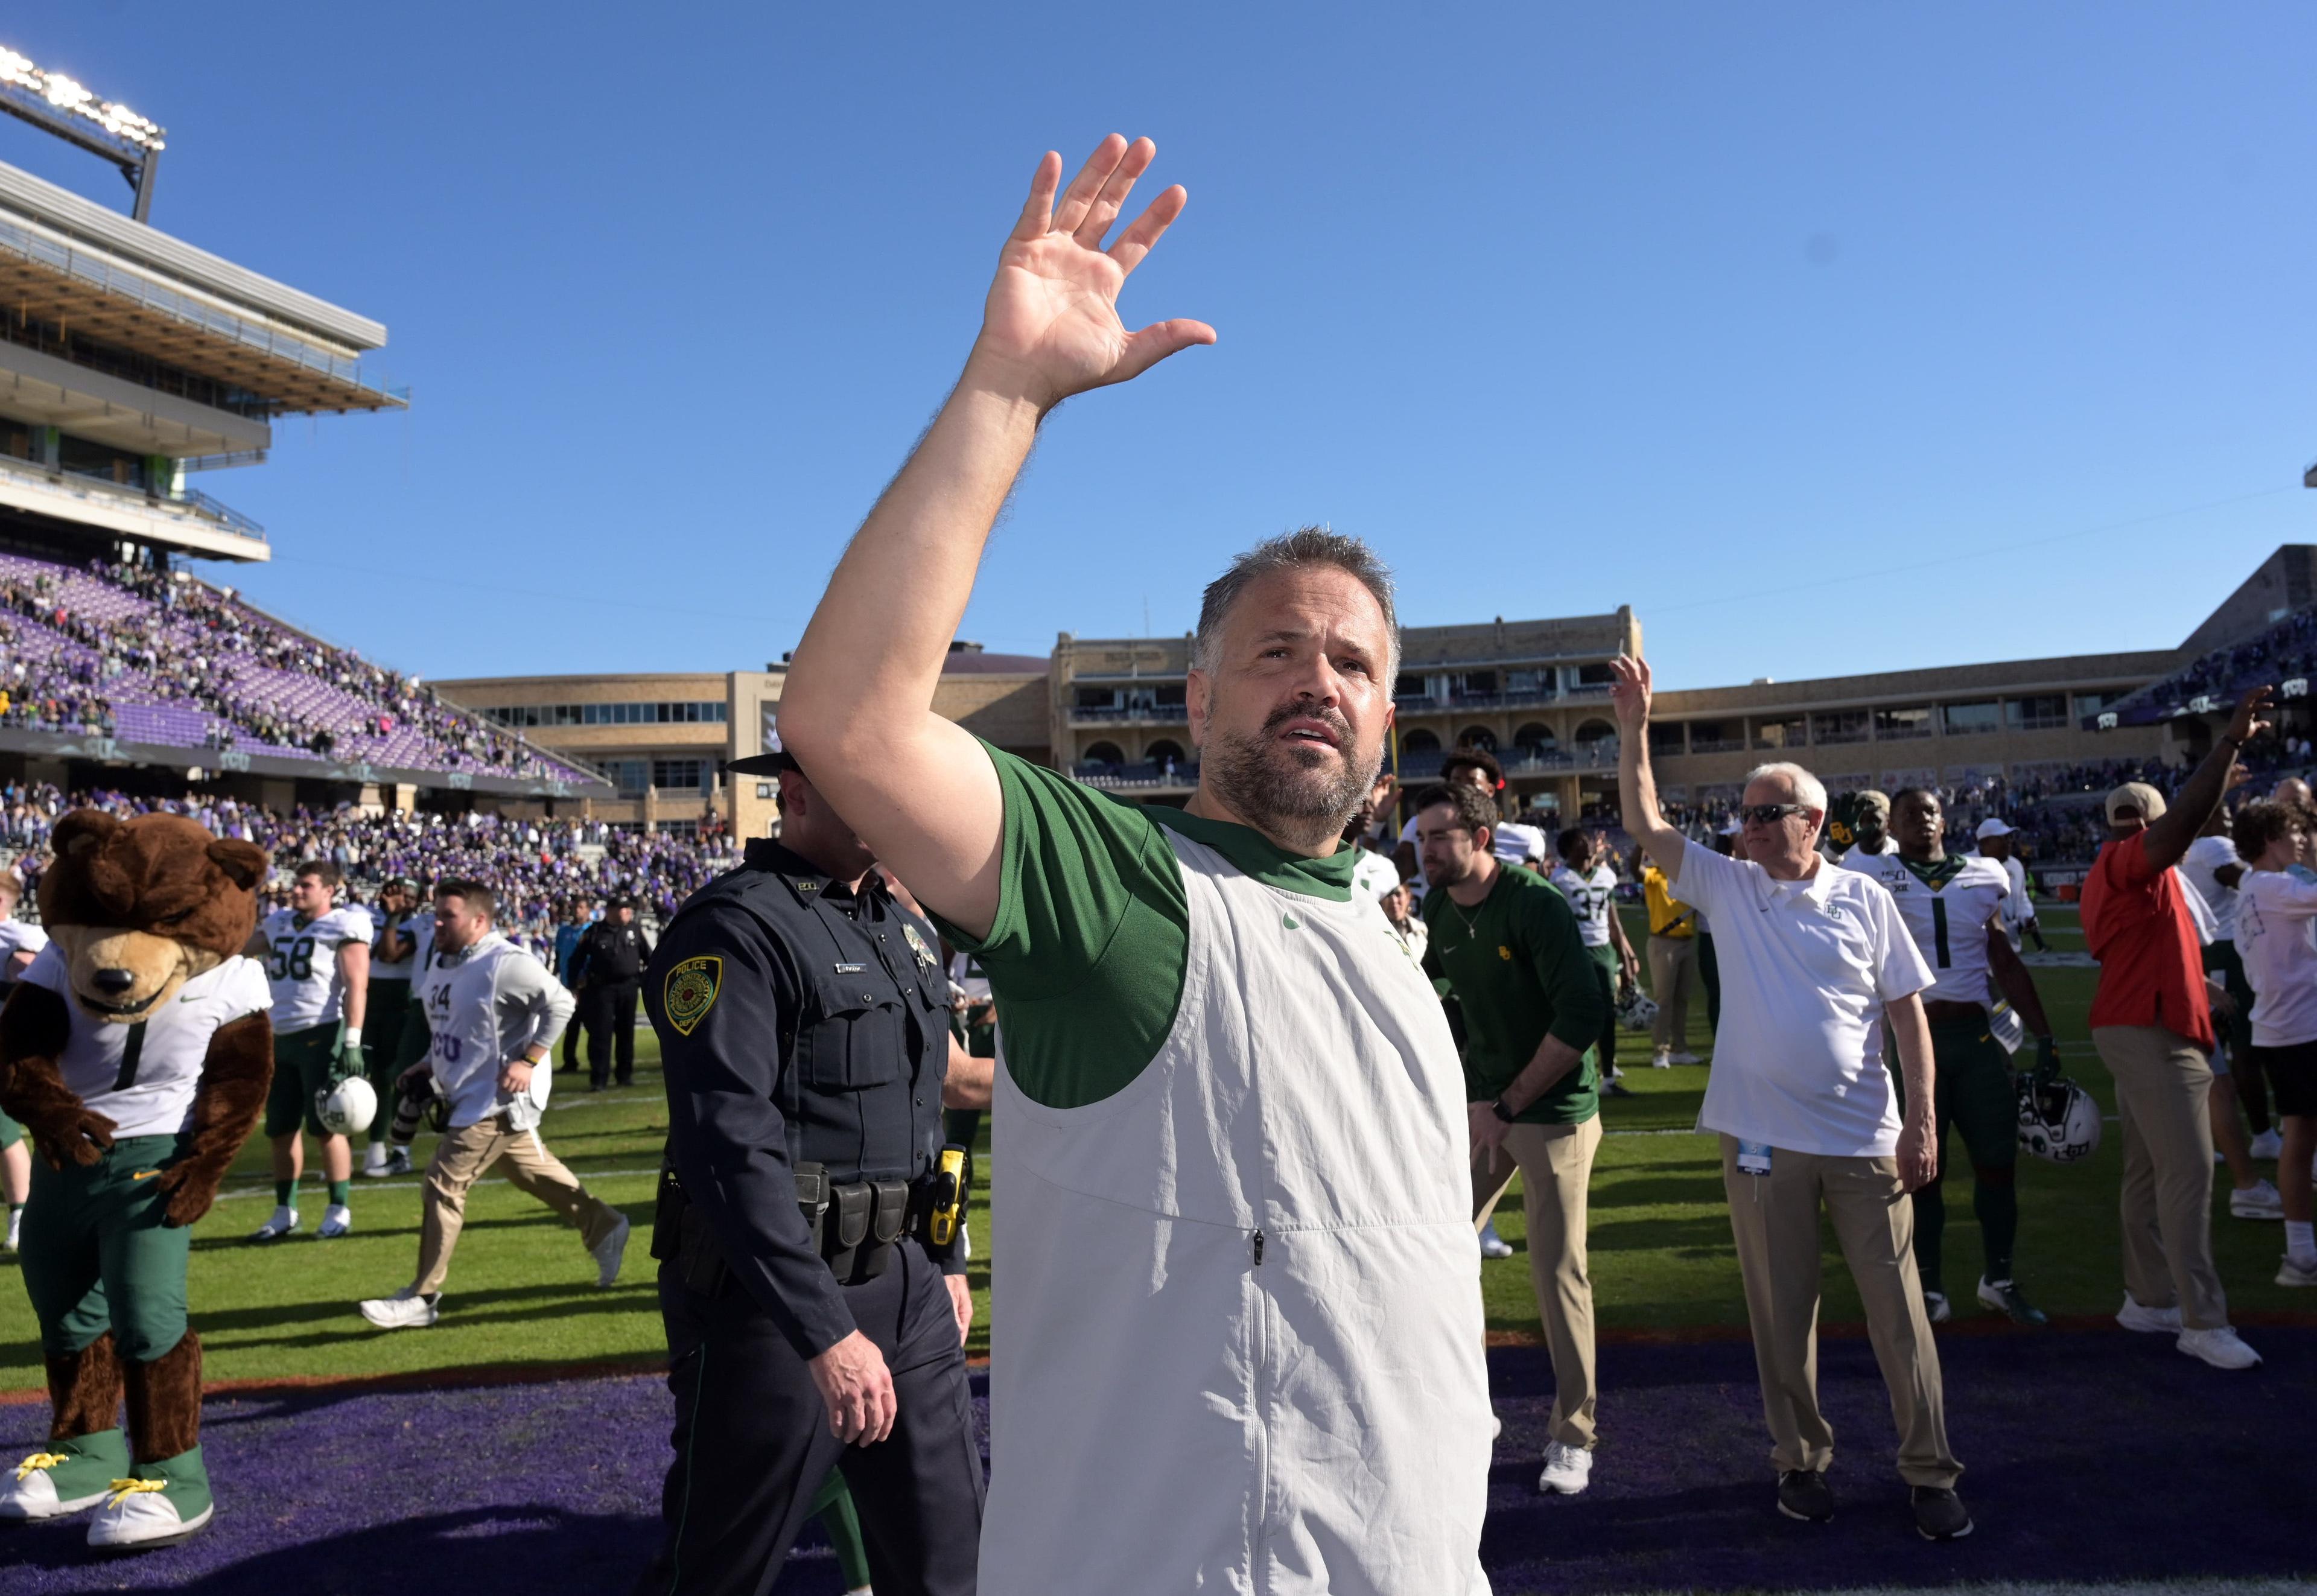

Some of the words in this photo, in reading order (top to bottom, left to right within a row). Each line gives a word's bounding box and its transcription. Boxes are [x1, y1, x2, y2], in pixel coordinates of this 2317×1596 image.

[1827, 905, 1841, 920] BU
[1931, 897, 1951, 968] 1
[272, 937, 314, 981] 58
[676, 961, 707, 977] POLICE
